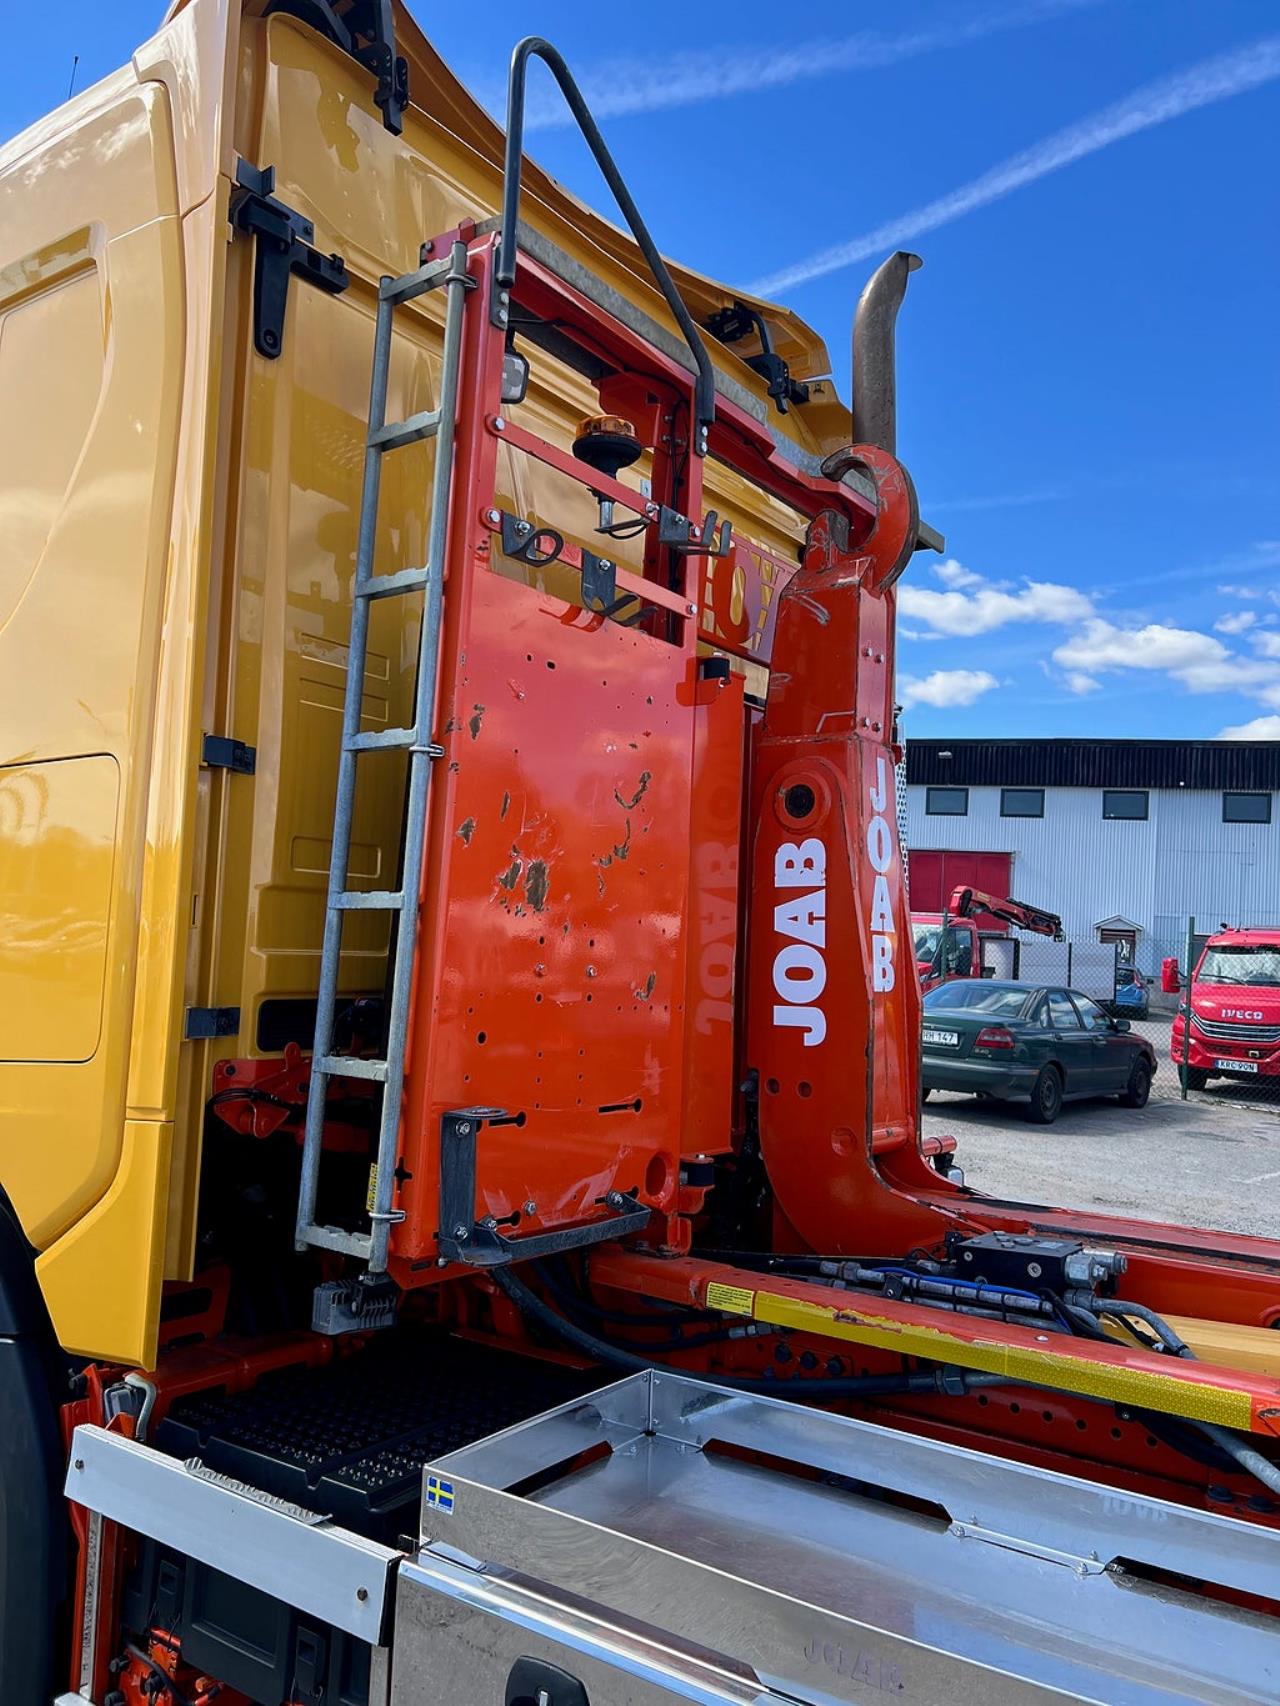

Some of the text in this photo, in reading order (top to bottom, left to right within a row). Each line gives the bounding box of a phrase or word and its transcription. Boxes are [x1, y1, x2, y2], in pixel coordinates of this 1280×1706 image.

[772, 837, 827, 1047] JOAB
[866, 757, 896, 993] JOAB
[1221, 1009, 1263, 1020] IVECO
